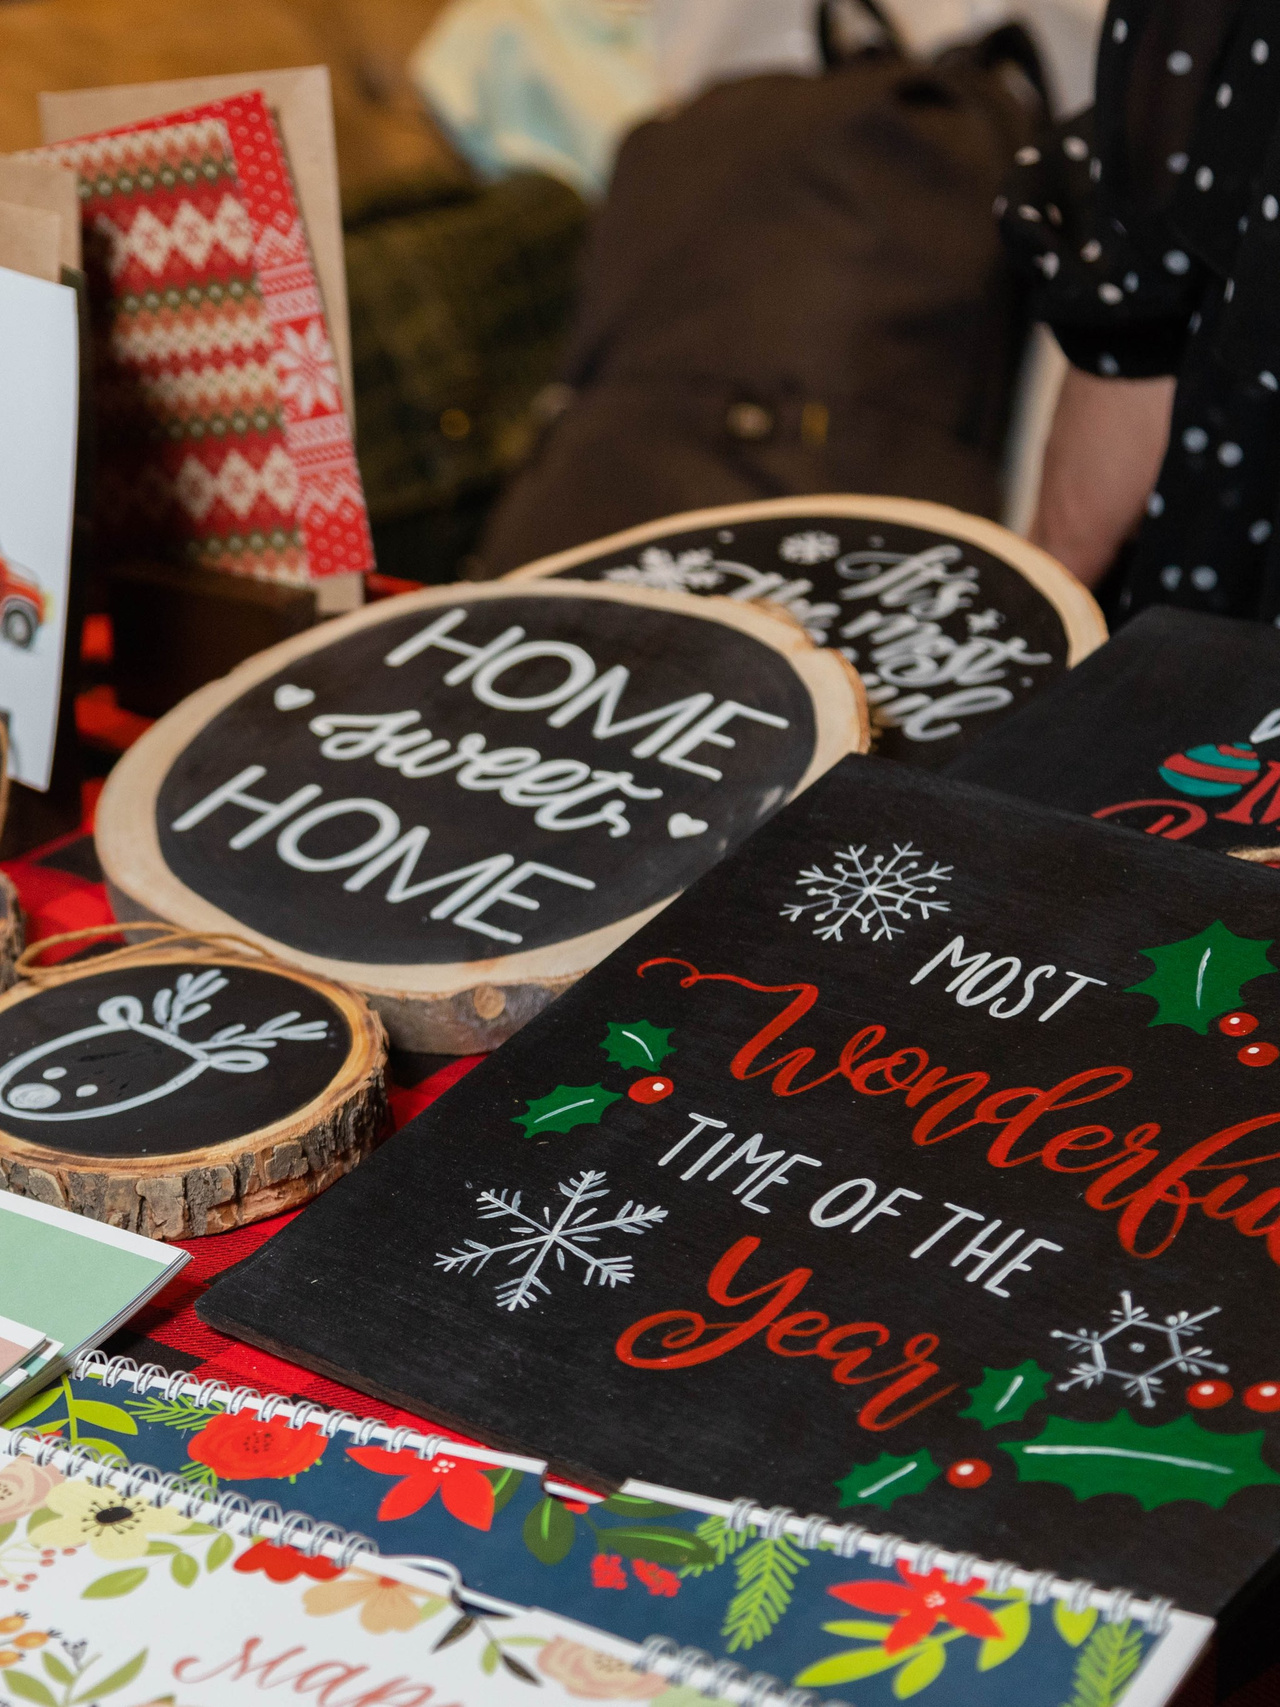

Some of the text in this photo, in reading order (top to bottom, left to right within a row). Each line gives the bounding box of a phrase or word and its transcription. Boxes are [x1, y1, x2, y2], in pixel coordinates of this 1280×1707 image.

[309, 709, 663, 838] sweet
[384, 608, 790, 782] HOME
[172, 764, 597, 945] HOME
[910, 935, 1107, 1021] MOST
[637, 957, 1280, 1266] Wonderfu
[658, 1112, 1063, 1298] TIME OF THE
[615, 1235, 961, 1432] Year
